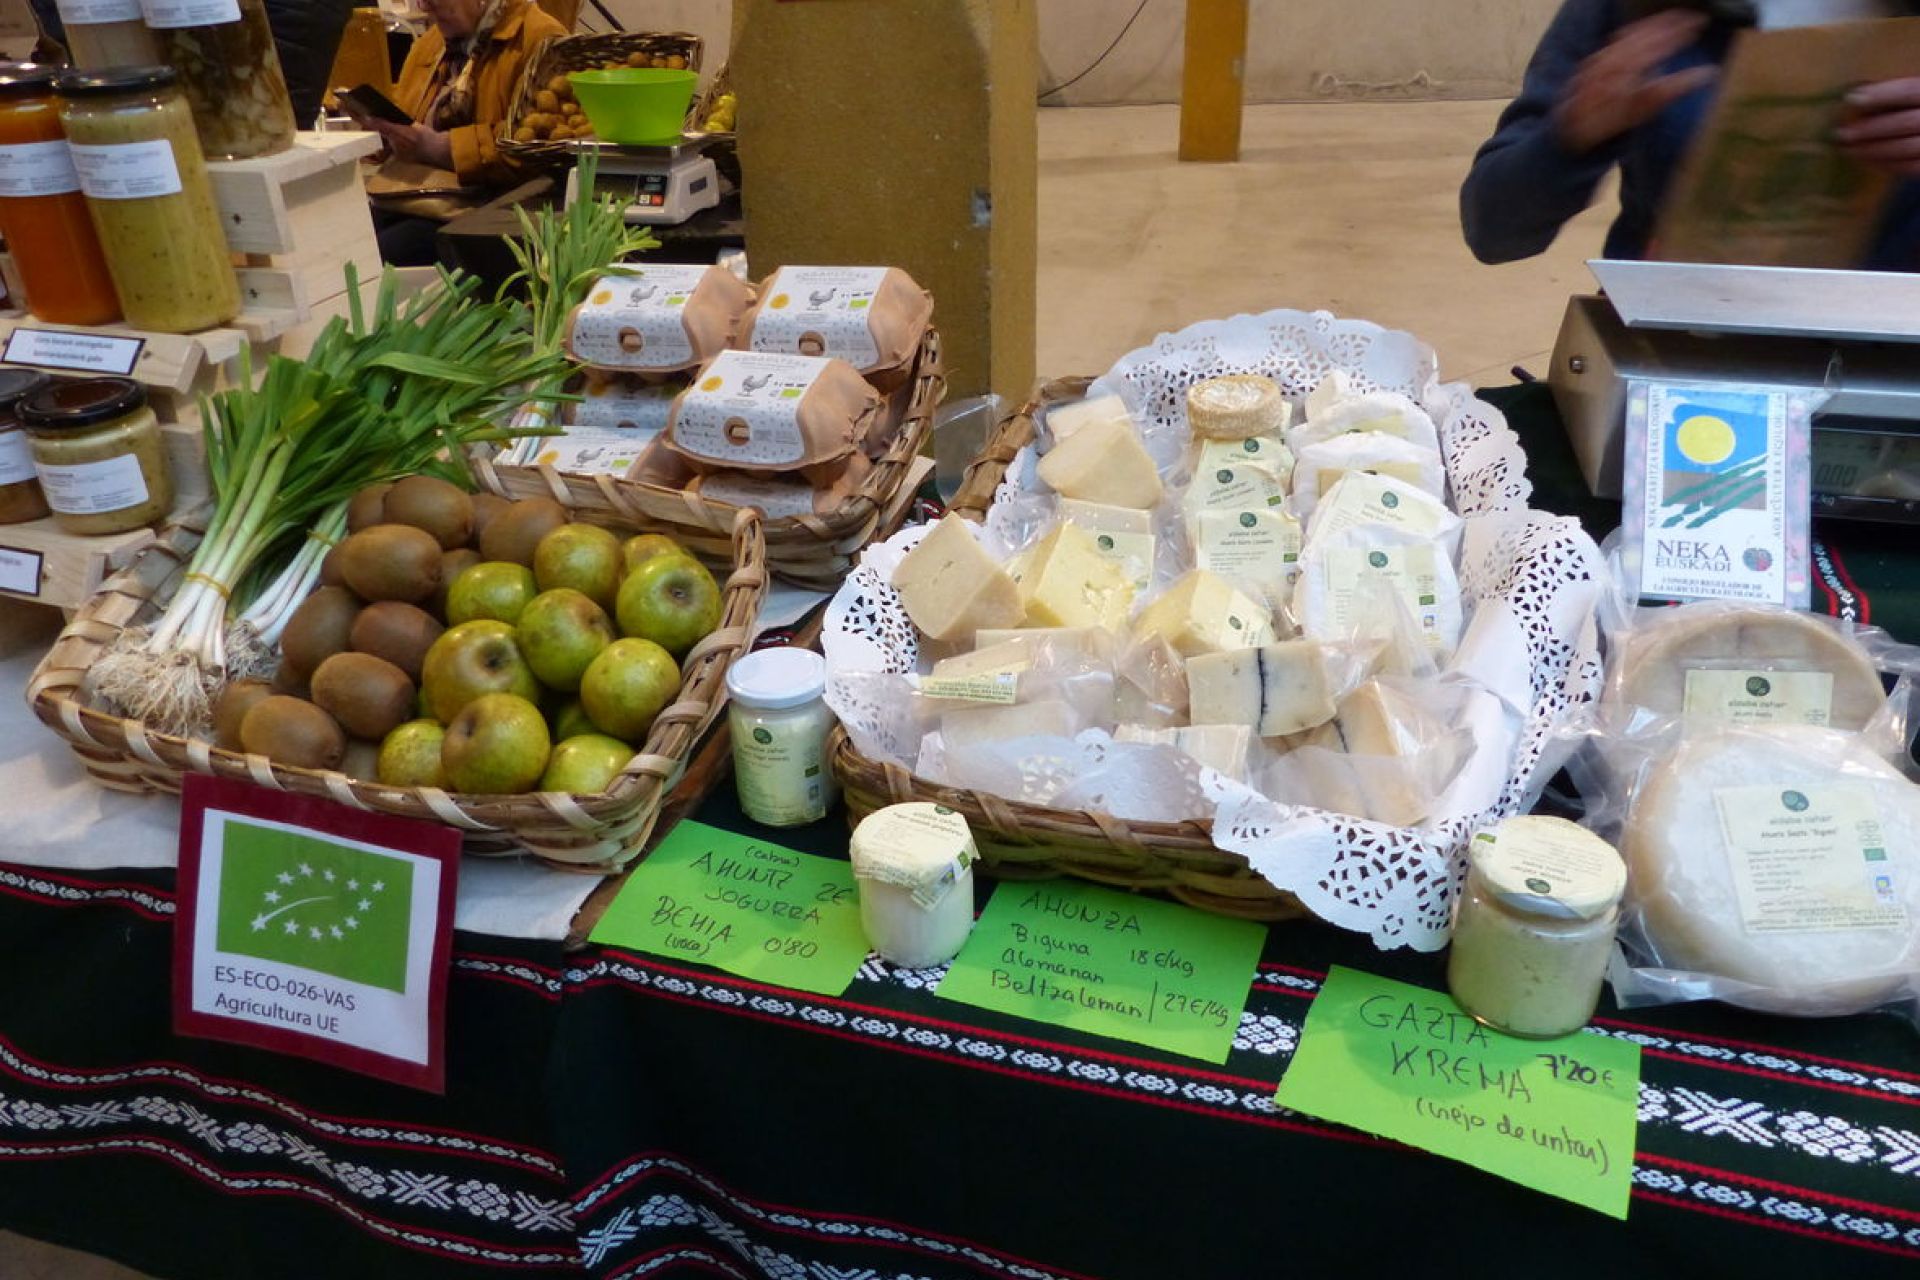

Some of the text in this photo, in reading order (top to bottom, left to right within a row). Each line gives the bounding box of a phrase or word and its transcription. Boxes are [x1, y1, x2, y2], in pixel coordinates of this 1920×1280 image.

[1655, 557, 1732, 572] EUSKADI
[1657, 539, 1730, 561] NEKA
[689, 850, 794, 890] AHUNTZ
[1019, 889, 1143, 935] AHUNZA
[1011, 922, 1091, 957] Biguna
[214, 965, 356, 1012] ES-ECO-026-VAS
[214, 991, 340, 1034] Agricultura UE
[1359, 994, 1491, 1049] GAZTA
[1390, 1041, 1533, 1104] KREMA
